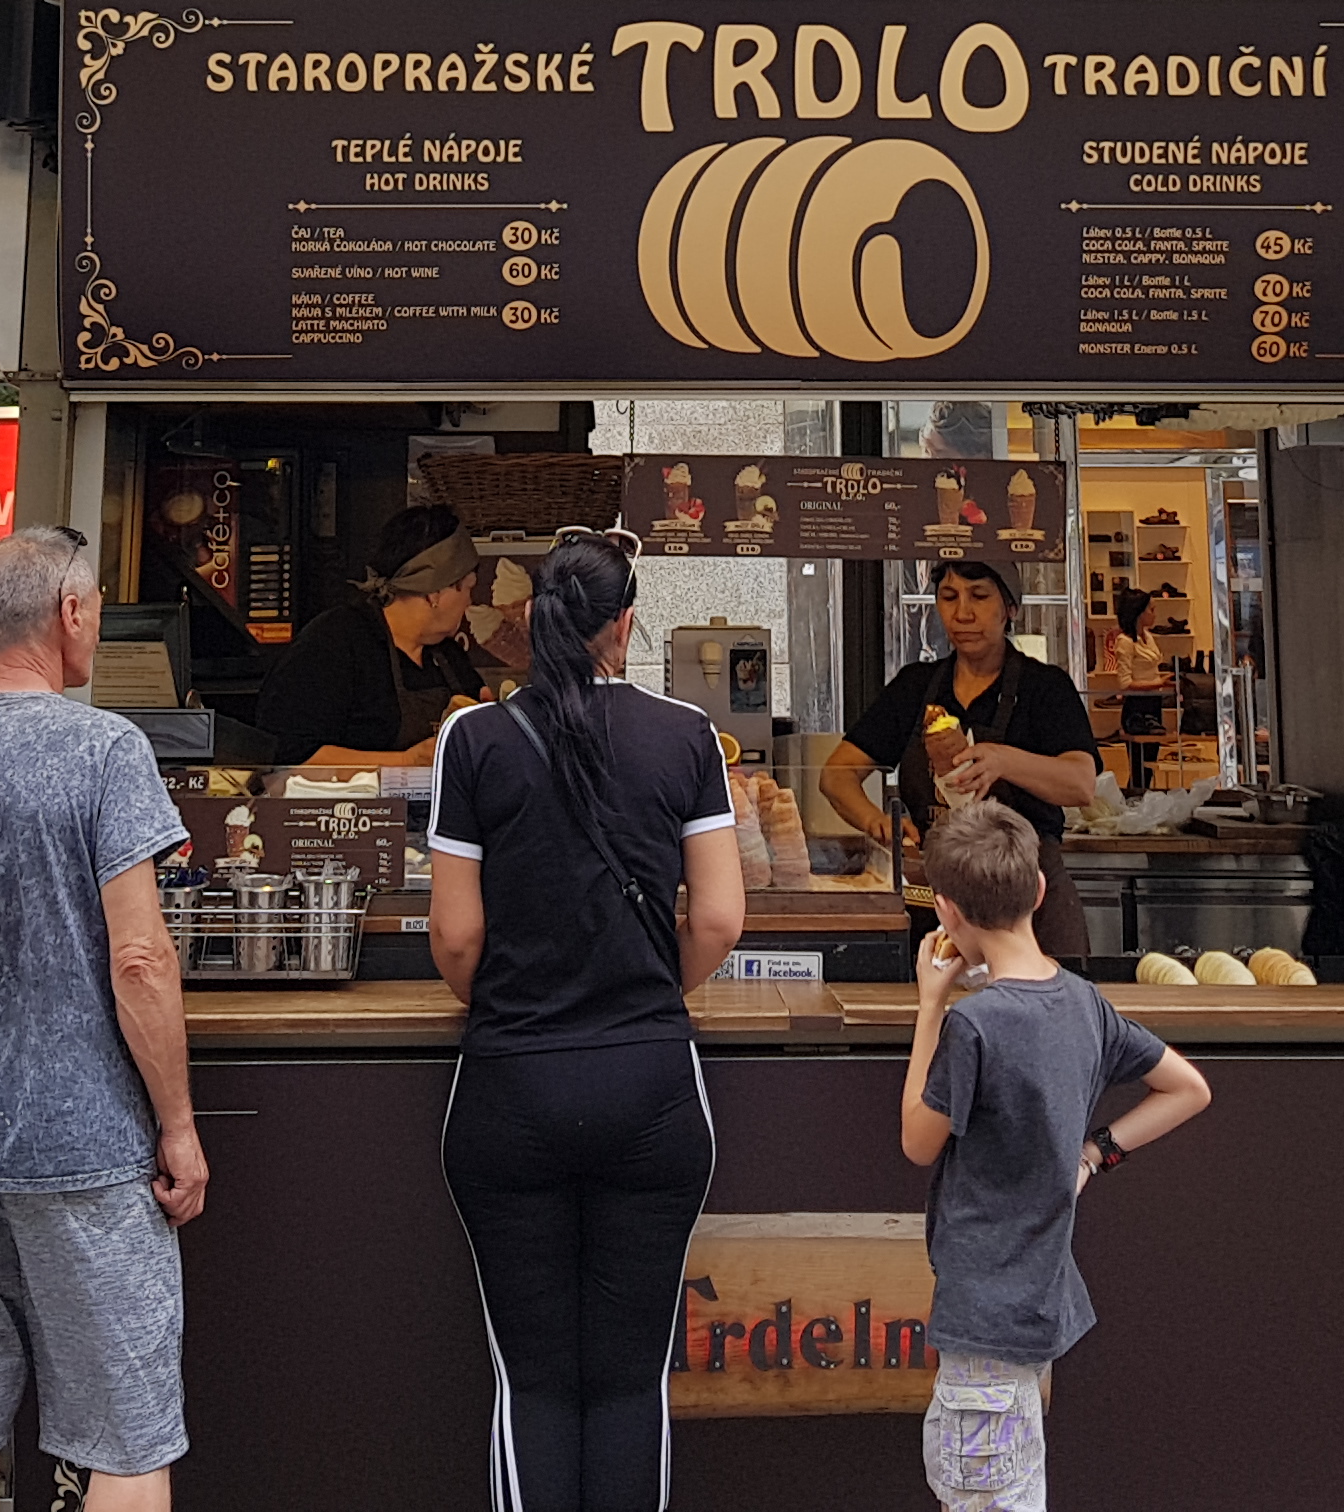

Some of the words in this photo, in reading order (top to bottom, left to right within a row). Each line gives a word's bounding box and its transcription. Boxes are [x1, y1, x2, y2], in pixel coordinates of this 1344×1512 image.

[206, 43, 595, 92] STAROPRAŽSKÉ
[612, 20, 1030, 133] TRDLO
[1043, 44, 1328, 98] TRADIČNÍ
[331, 133, 413, 164] TEPLÉ
[422, 133, 523, 164] NÁPOJE
[1082, 136, 1202, 166] STUDENÉ
[1211, 136, 1309, 166] NÁPOJE
[365, 173, 408, 192] HOT
[414, 173, 489, 192] DRINKS
[1129, 174, 1182, 193] COLD
[1188, 174, 1261, 193] DRINKS
[291, 225, 311, 239] ČAJ
[323, 227, 345, 239] TEA
[508, 226, 533, 245] 30
[540, 228, 560, 245] Kč
[1153, 227, 1182, 238] Bottle
[291, 238, 331, 252] HORKÁ
[334, 238, 393, 252] ČOKOLÁDA
[405, 240, 429, 252] HOT
[431, 240, 497, 252] CHOCOLATE
[1082, 240, 1112, 251] COCA
[1191, 240, 1230, 251] SPRITE
[1259, 236, 1285, 255] 45
[1293, 238, 1313, 255] Kč
[1172, 253, 1225, 264] BONAQUA
[291, 265, 343, 279] SVAŘENÉ
[346, 265, 373, 279] VÍNO
[384, 267, 408, 278] HOT
[411, 267, 440, 278] WINE
[508, 262, 533, 279] 60
[540, 264, 560, 280] Kč
[1142, 274, 1171, 285] Bottle
[1081, 288, 1111, 299] COCA
[1190, 288, 1228, 299] SPRITE
[1260, 279, 1285, 298] 70
[1292, 281, 1312, 298] Kč
[291, 292, 322, 305] KÁVA
[333, 294, 375, 305] COFFEE
[291, 305, 322, 318] KÁVA
[394, 306, 436, 317] COFFEE
[439, 306, 468, 317] WITH
[471, 306, 498, 317] MILK
[508, 306, 533, 324] 30
[540, 307, 560, 324] Kč
[1150, 309, 1179, 320] Bottle
[292, 320, 327, 331] LATTE
[329, 319, 388, 331] MACHIATO
[1258, 310, 1283, 328] 70
[1290, 311, 1310, 328] Kč
[1080, 322, 1133, 333] BONAQUA
[292, 332, 363, 344] CAPPUCCINO
[1079, 343, 1131, 354] MONSTER
[1256, 340, 1282, 358] 60
[1289, 341, 1309, 358] Kč
[823, 476, 882, 494] TRDLO
[800, 501, 844, 510] ORIGINAL
[207, 470, 231, 589] café+co
[188, 775, 205, 790] Kč
[317, 816, 371, 832] TRDLO
[291, 839, 335, 848] ORIGINAL
[767, 959, 781, 967] Find
[671, 1275, 928, 1373] Trdeln
